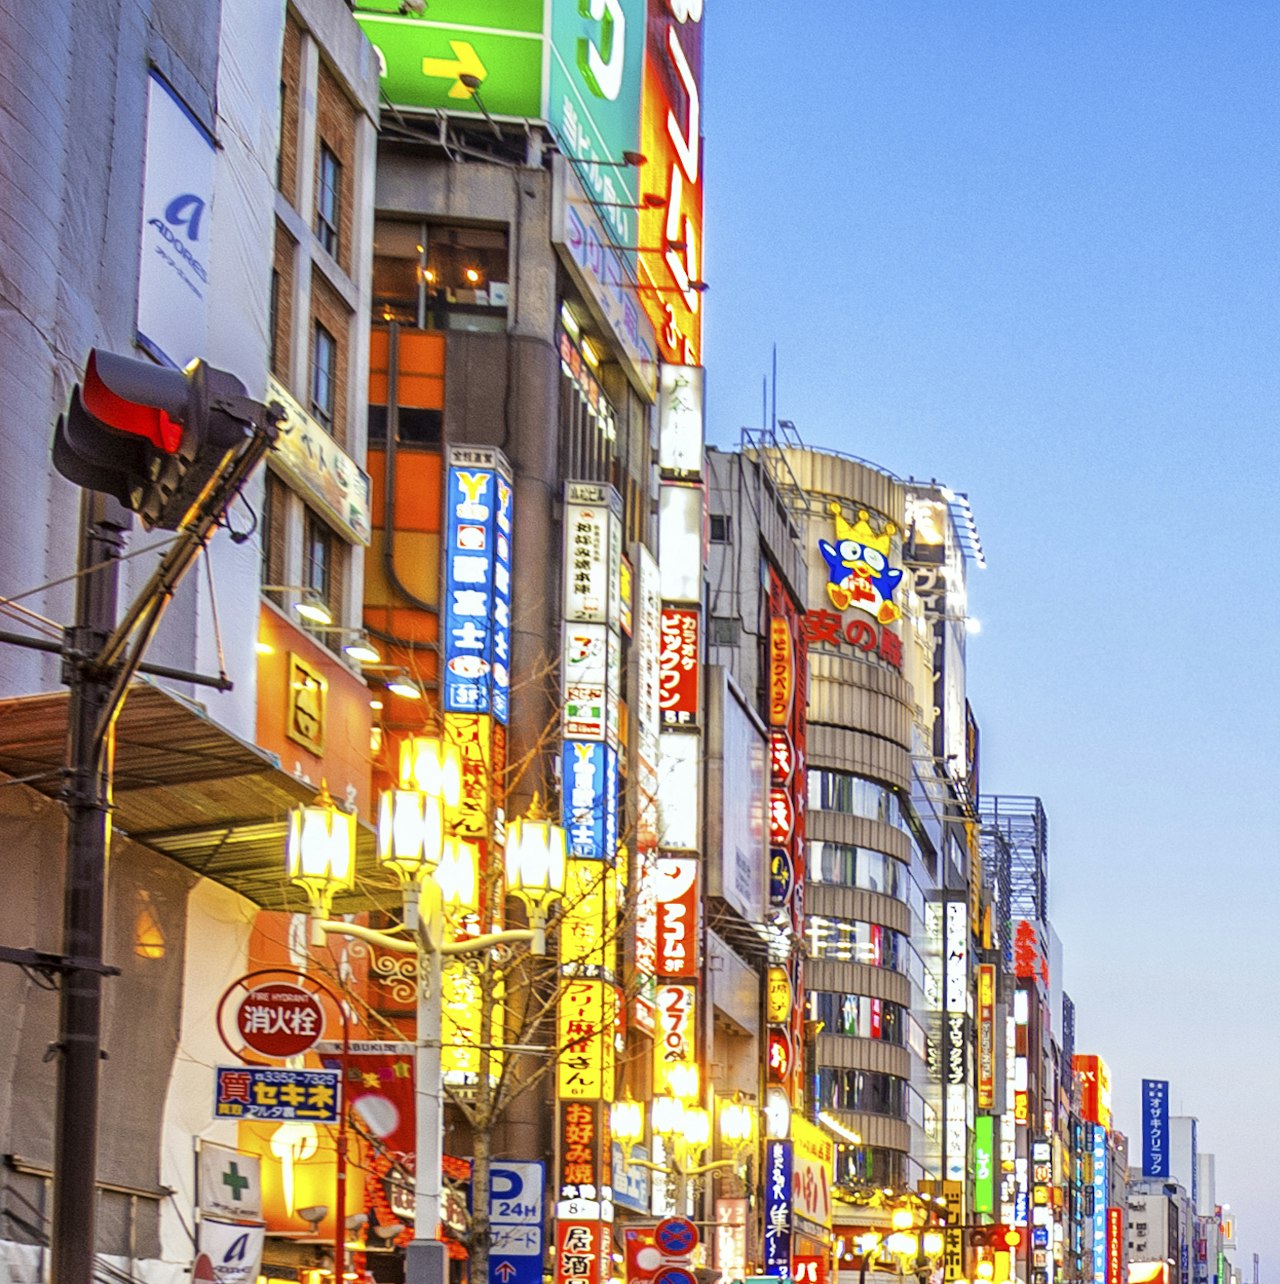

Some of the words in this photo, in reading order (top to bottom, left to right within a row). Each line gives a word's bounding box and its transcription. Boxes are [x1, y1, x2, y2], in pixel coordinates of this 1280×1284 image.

[681, 615, 698, 671] カラオケ
[664, 710, 690, 724] 5F
[663, 903, 687, 958] アコム
[250, 992, 271, 1002] FIRE
[271, 992, 311, 1003] HYDRANT
[244, 1005, 318, 1036] 消火栓
[219, 1072, 252, 1103] 質
[252, 1083, 335, 1107] セキネ
[565, 1102, 594, 1185] お好み焼
[1150, 1098, 1162, 1175] オザキクリニック
[499, 1201, 537, 1217] 24H
